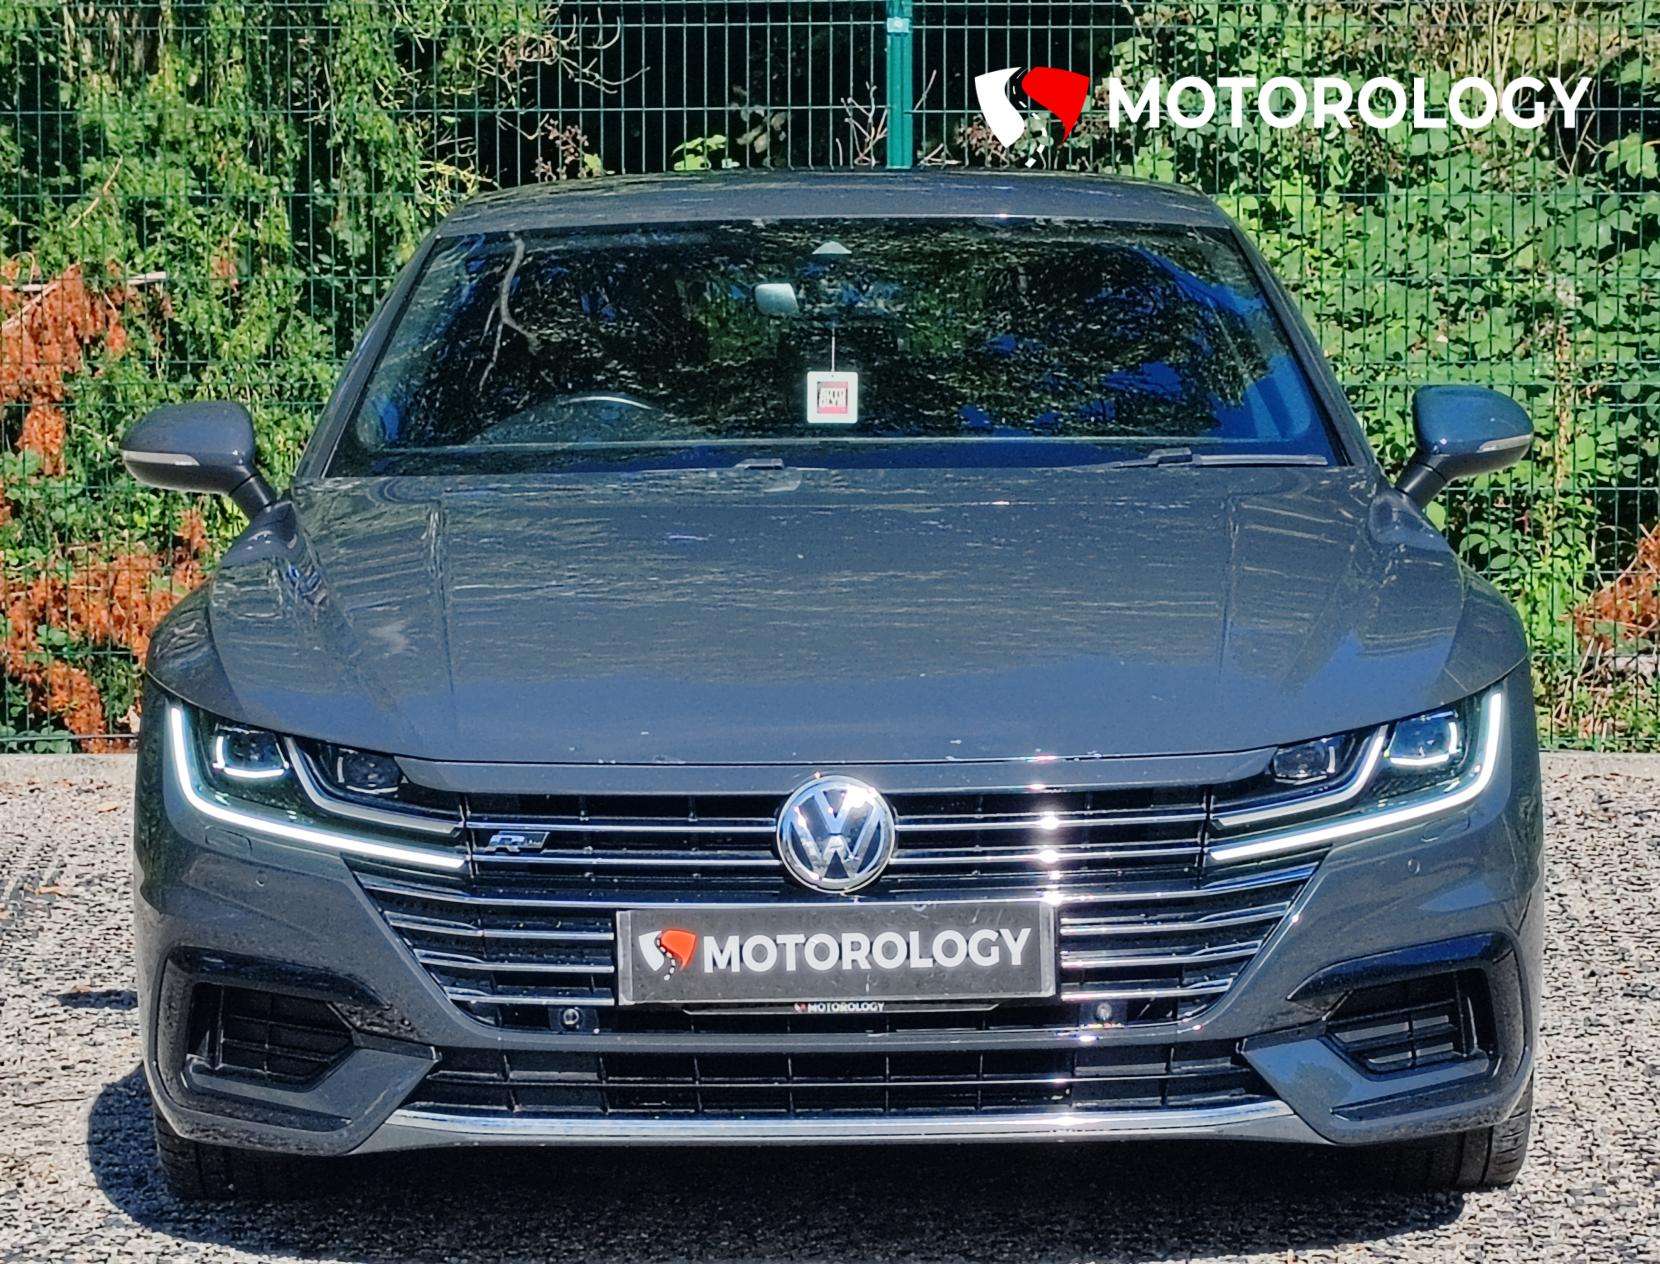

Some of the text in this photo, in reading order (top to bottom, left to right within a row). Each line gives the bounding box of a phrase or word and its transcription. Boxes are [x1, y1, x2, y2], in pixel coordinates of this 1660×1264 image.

[784, 781, 888, 886] VW
[703, 927, 1032, 974] MOTOROLOGY
[807, 1001, 885, 1013] MOTOROLOGY
